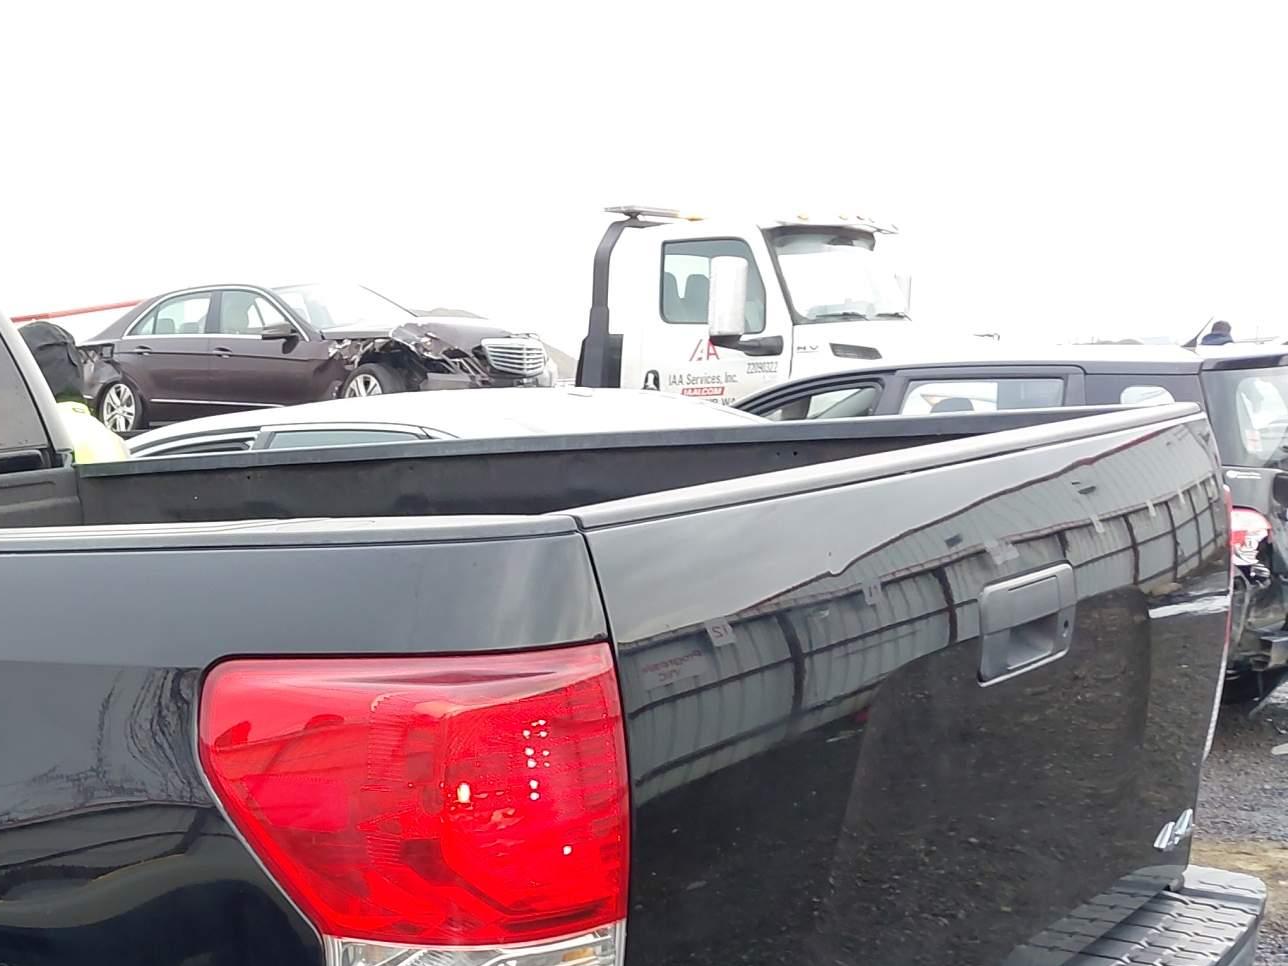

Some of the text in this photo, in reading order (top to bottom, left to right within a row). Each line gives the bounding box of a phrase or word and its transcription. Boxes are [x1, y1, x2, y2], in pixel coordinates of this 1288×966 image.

[668, 371, 739, 386] IAA Services, Inc.
